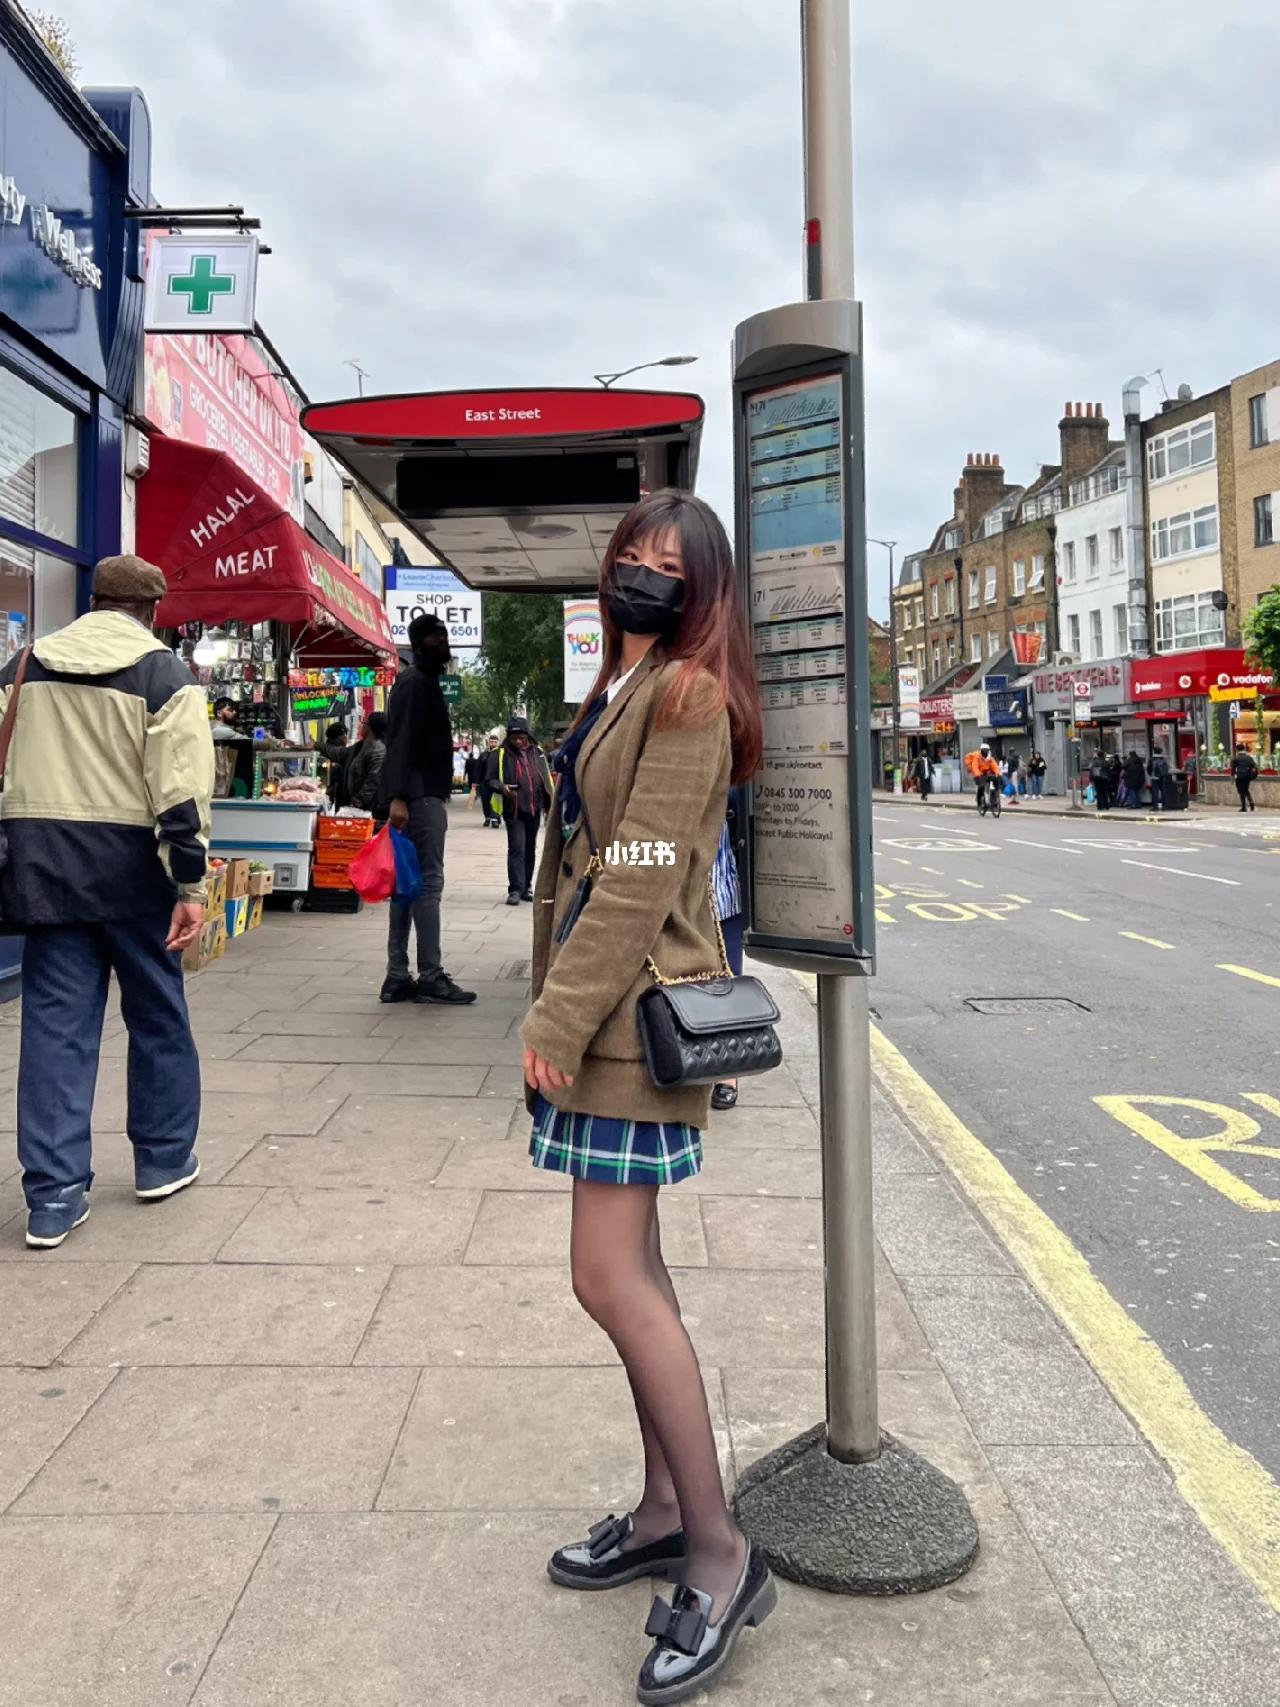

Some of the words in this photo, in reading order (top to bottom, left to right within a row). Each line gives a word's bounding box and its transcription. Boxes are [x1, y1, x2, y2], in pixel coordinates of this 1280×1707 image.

[465, 409, 496, 421] East
[498, 408, 542, 420] Street
[190, 488, 256, 548] HALAL
[215, 545, 278, 578] MEAT
[416, 594, 453, 605] SHOP
[451, 626, 478, 637] 6501
[567, 632, 599, 643] THANK
[572, 641, 599, 655] YOU
[788, 789, 805, 799] 300
[808, 789, 832, 800] 7000
